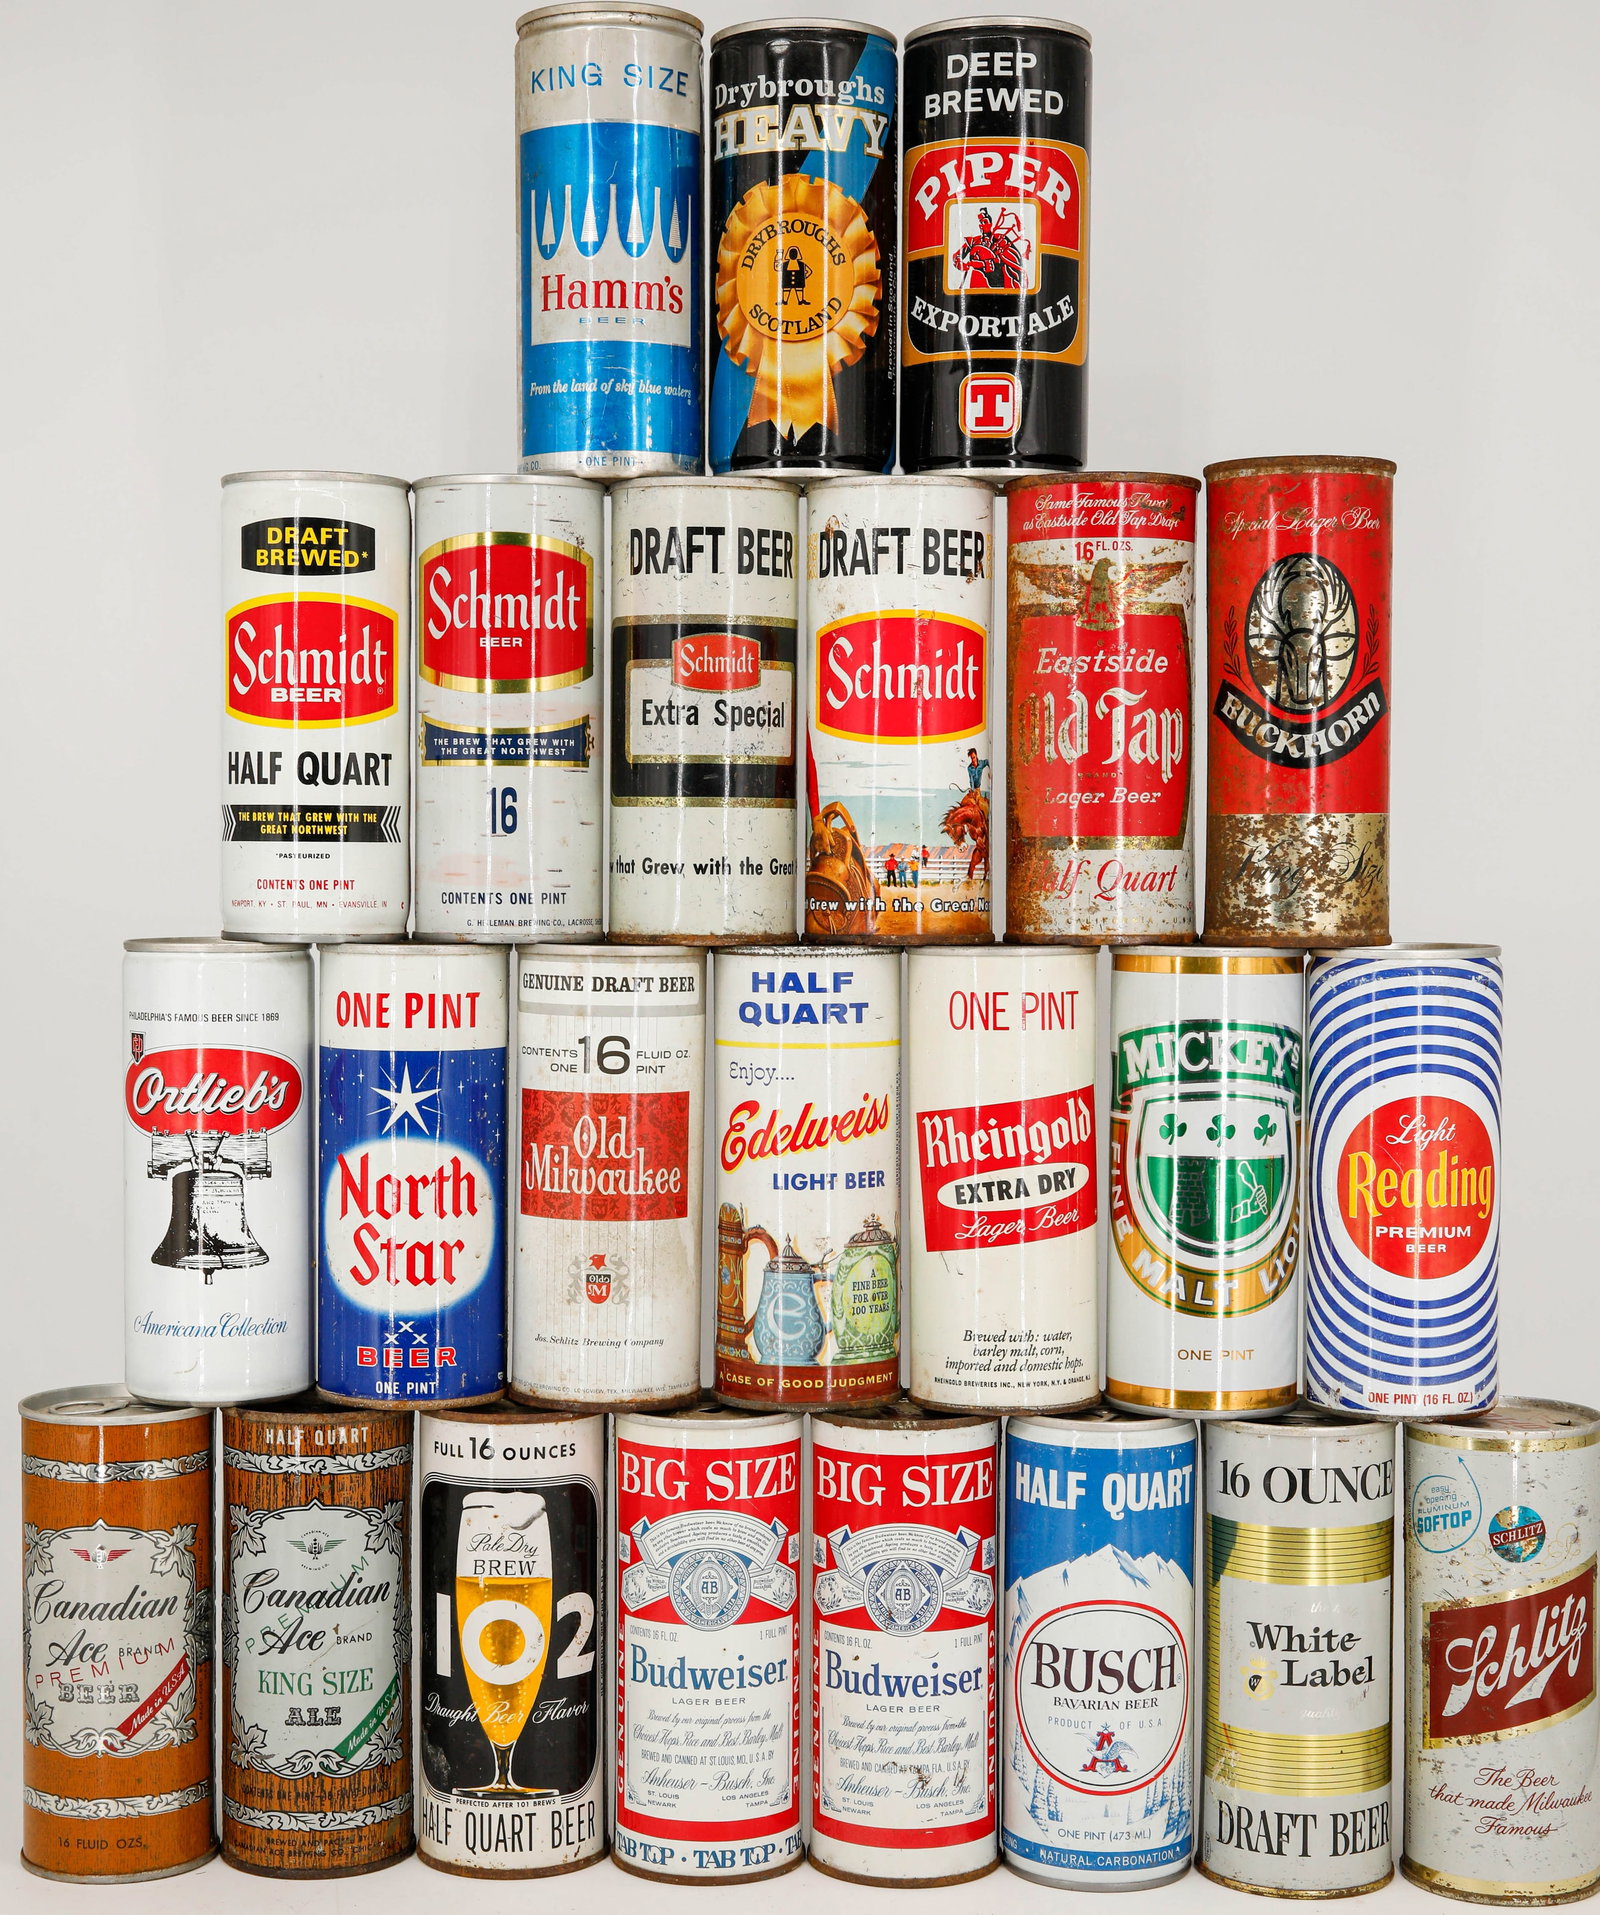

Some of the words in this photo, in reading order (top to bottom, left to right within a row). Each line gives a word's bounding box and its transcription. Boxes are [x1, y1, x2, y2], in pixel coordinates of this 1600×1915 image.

[531, 62, 603, 94] KING
[623, 63, 689, 97] SIZE
[947, 52, 1038, 79] DEEP
[714, 74, 885, 110] Drybroughs
[924, 88, 1064, 118] BREWED
[714, 104, 888, 161] HEAVY
[914, 151, 1072, 221] PIPER
[741, 218, 847, 271] DRYBROUGHS
[541, 274, 683, 314] Hamm's
[579, 317, 645, 325] BEER
[749, 296, 842, 336] SCOTLAND
[970, 384, 1009, 428] T
[585, 456, 607, 466] ONE
[612, 456, 636, 466] PINT
[267, 527, 349, 546] DRAFT
[630, 526, 726, 575] DRAFT
[738, 527, 794, 579] BEER
[819, 528, 911, 578] DRAFT
[922, 528, 984, 579] BEER
[1074, 542, 1094, 561] 16
[1095, 541, 1109, 552] FL.
[1112, 540, 1134, 552] OZS.
[428, 565, 580, 640] Schmidt
[232, 621, 388, 696] Schmidt
[479, 636, 522, 648] BEER
[680, 644, 756, 678] Schmidt
[826, 636, 979, 709] Schmidt
[1034, 646, 1169, 675] Eastside
[270, 687, 342, 703] BEER
[641, 699, 699, 727] Extra
[714, 700, 785, 729] Special
[1220, 691, 1382, 759] BUCKHORN
[1095, 686, 1183, 784] Tap
[228, 751, 282, 785] HALF
[297, 751, 392, 788] QUART
[486, 786, 518, 836] 16
[257, 879, 305, 891] CONTENTS
[309, 879, 329, 891] ONE
[332, 879, 356, 891] PINT
[441, 892, 502, 905] CONTENTS
[509, 892, 534, 905] ONE
[541, 892, 567, 905] PINT
[523, 973, 584, 992] GENUINE
[591, 976, 654, 992] DRAFT
[658, 976, 695, 992] BEER
[751, 971, 854, 994] HALF
[336, 991, 391, 1029] ONE
[404, 991, 480, 1029] PINT
[739, 1001, 869, 1028] QUART
[949, 990, 1010, 1031] ONE
[1020, 990, 1079, 1031] PINT
[521, 1046, 578, 1059] CONTENTS
[550, 1064, 578, 1074] ONE
[578, 1035, 631, 1076] 16
[636, 1050, 671, 1060] FLUID
[676, 1049, 691, 1059] OZ.
[636, 1064, 666, 1074] PINT
[132, 1066, 289, 1114] Ortlieb's
[573, 1115, 634, 1159] Old
[721, 1092, 891, 1174] Edelweiss
[922, 1096, 1091, 1168] Rheingold
[1386, 1114, 1456, 1151] Light
[338, 1151, 478, 1221] North
[525, 1143, 681, 1195] Milwaukee
[772, 1172, 837, 1191] LIGHT
[844, 1170, 885, 1190] BEER
[1347, 1148, 1492, 1220] Reading
[955, 1177, 1031, 1206] EXTRA
[1038, 1167, 1077, 1195] DRY
[954, 1215, 1026, 1243] Lager
[1028, 1205, 1080, 1231] Beer
[1375, 1226, 1471, 1239] PREMIUM
[349, 1222, 464, 1288] Star
[1405, 1243, 1447, 1254] BEER
[1132, 1249, 1239, 1307] MALT
[134, 1311, 218, 1338] Americana
[219, 1312, 288, 1338] Collection
[357, 1346, 458, 1368] BEER
[1177, 1349, 1212, 1361] ONE
[1220, 1349, 1255, 1361] PINT
[375, 1381, 400, 1394] ONE
[406, 1381, 437, 1394] PINT
[719, 1371, 725, 1384] A
[726, 1372, 752, 1386] CASE
[758, 1375, 774, 1388] OF
[781, 1376, 824, 1388] GOOD
[831, 1371, 894, 1388] JUDGMENT
[1367, 1391, 1390, 1405] ONE
[1393, 1392, 1420, 1406] PINT
[1423, 1391, 1439, 1406] (16
[1442, 1391, 1456, 1405] FL.
[1458, 1391, 1473, 1405] OZ.)
[266, 1426, 304, 1445] HALF
[314, 1426, 369, 1445] QUART
[434, 1440, 464, 1459] FULL
[469, 1436, 495, 1461] 16
[502, 1442, 576, 1461] OUNCES
[621, 1451, 690, 1501] BIG
[706, 1452, 797, 1502] SIZE
[816, 1456, 886, 1507] BIG
[902, 1457, 994, 1508] SIZE
[1016, 1461, 1087, 1511] HALF
[1102, 1464, 1192, 1521] QUART
[1219, 1459, 1250, 1499] 16
[1262, 1459, 1392, 1505] OUNCE
[1417, 1509, 1472, 1534] SOFTOP
[1491, 1522, 1544, 1546] SCHLITZ
[466, 1532, 504, 1553] Pale
[503, 1534, 539, 1558] Dry
[473, 1560, 537, 1576] BREW
[33, 1579, 178, 1625] Canadian
[243, 1568, 391, 1614] Canadian
[49, 1628, 109, 1668] Ace
[259, 1616, 324, 1655] Ace
[436, 1591, 596, 1684] 102
[1246, 1620, 1361, 1654] White
[631, 1642, 789, 1692] Budweiser
[1031, 1641, 1177, 1695] BUSCH
[1280, 1656, 1376, 1688] Label
[1441, 1595, 1588, 1716] Schlitz
[258, 1669, 313, 1696] KING
[322, 1668, 374, 1696] SIZE
[825, 1649, 983, 1699] Budweiser
[58, 1682, 140, 1705] BEER
[671, 1697, 710, 1706] LAGER
[714, 1697, 747, 1706] BEER
[866, 1703, 904, 1712] LAGER
[908, 1704, 940, 1713] BEER
[1053, 1696, 1119, 1711] BAVARIAN
[1125, 1696, 1159, 1709] BEER
[286, 1706, 342, 1726] ALE
[1473, 1767, 1513, 1788] The
[1516, 1766, 1559, 1789] Beer
[1429, 1784, 1464, 1806] that
[1464, 1796, 1515, 1812] made
[1515, 1790, 1592, 1815] Milwaukee
[422, 1796, 452, 1846] HALF
[465, 1812, 537, 1853] QUART
[551, 1800, 596, 1850] BEER
[1216, 1799, 1318, 1858] DRAFT
[1329, 1800, 1390, 1858] BEER
[1474, 1816, 1558, 1836] Famous
[58, 1838, 69, 1849] 16
[76, 1837, 109, 1849] FLUID
[116, 1835, 148, 1849] OZS.
[1040, 1849, 1092, 1868] NATURAL
[1097, 1849, 1174, 1867] CARBONATION
